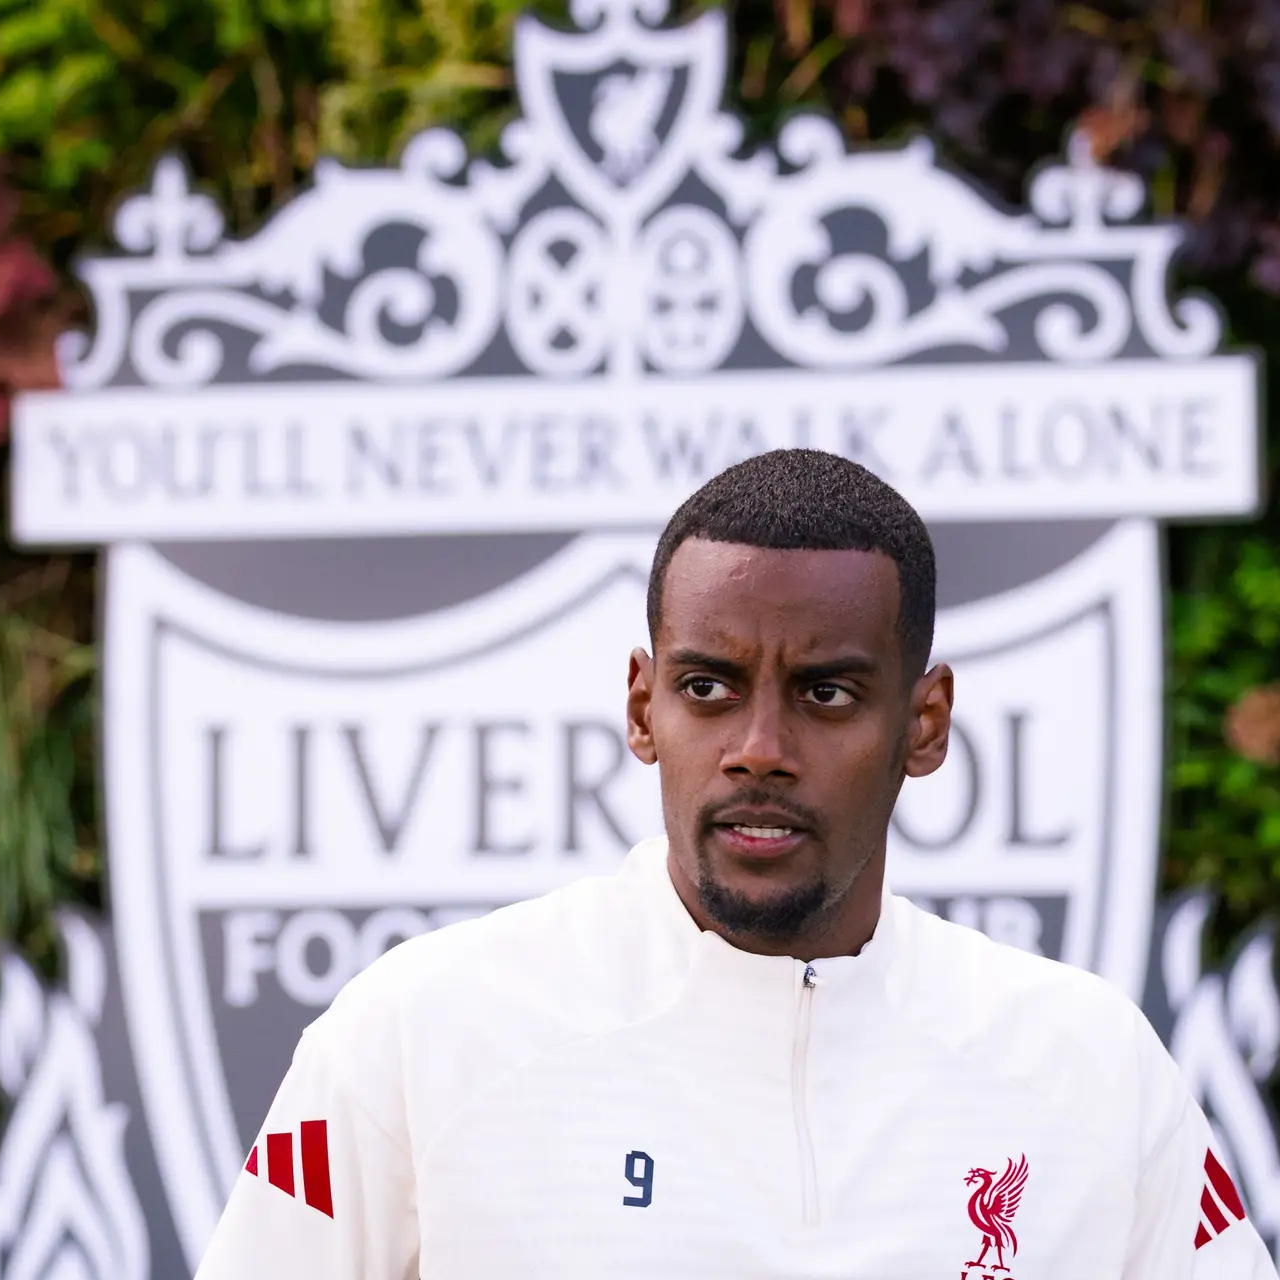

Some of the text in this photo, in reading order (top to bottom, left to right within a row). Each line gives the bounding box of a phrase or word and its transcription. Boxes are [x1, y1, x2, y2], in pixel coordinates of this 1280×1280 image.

[344, 410, 627, 496] NEVER
[916, 396, 1222, 484] ALONE
[201, 711, 1074, 860] LIVEROL
[623, 1150, 655, 1208] 9
